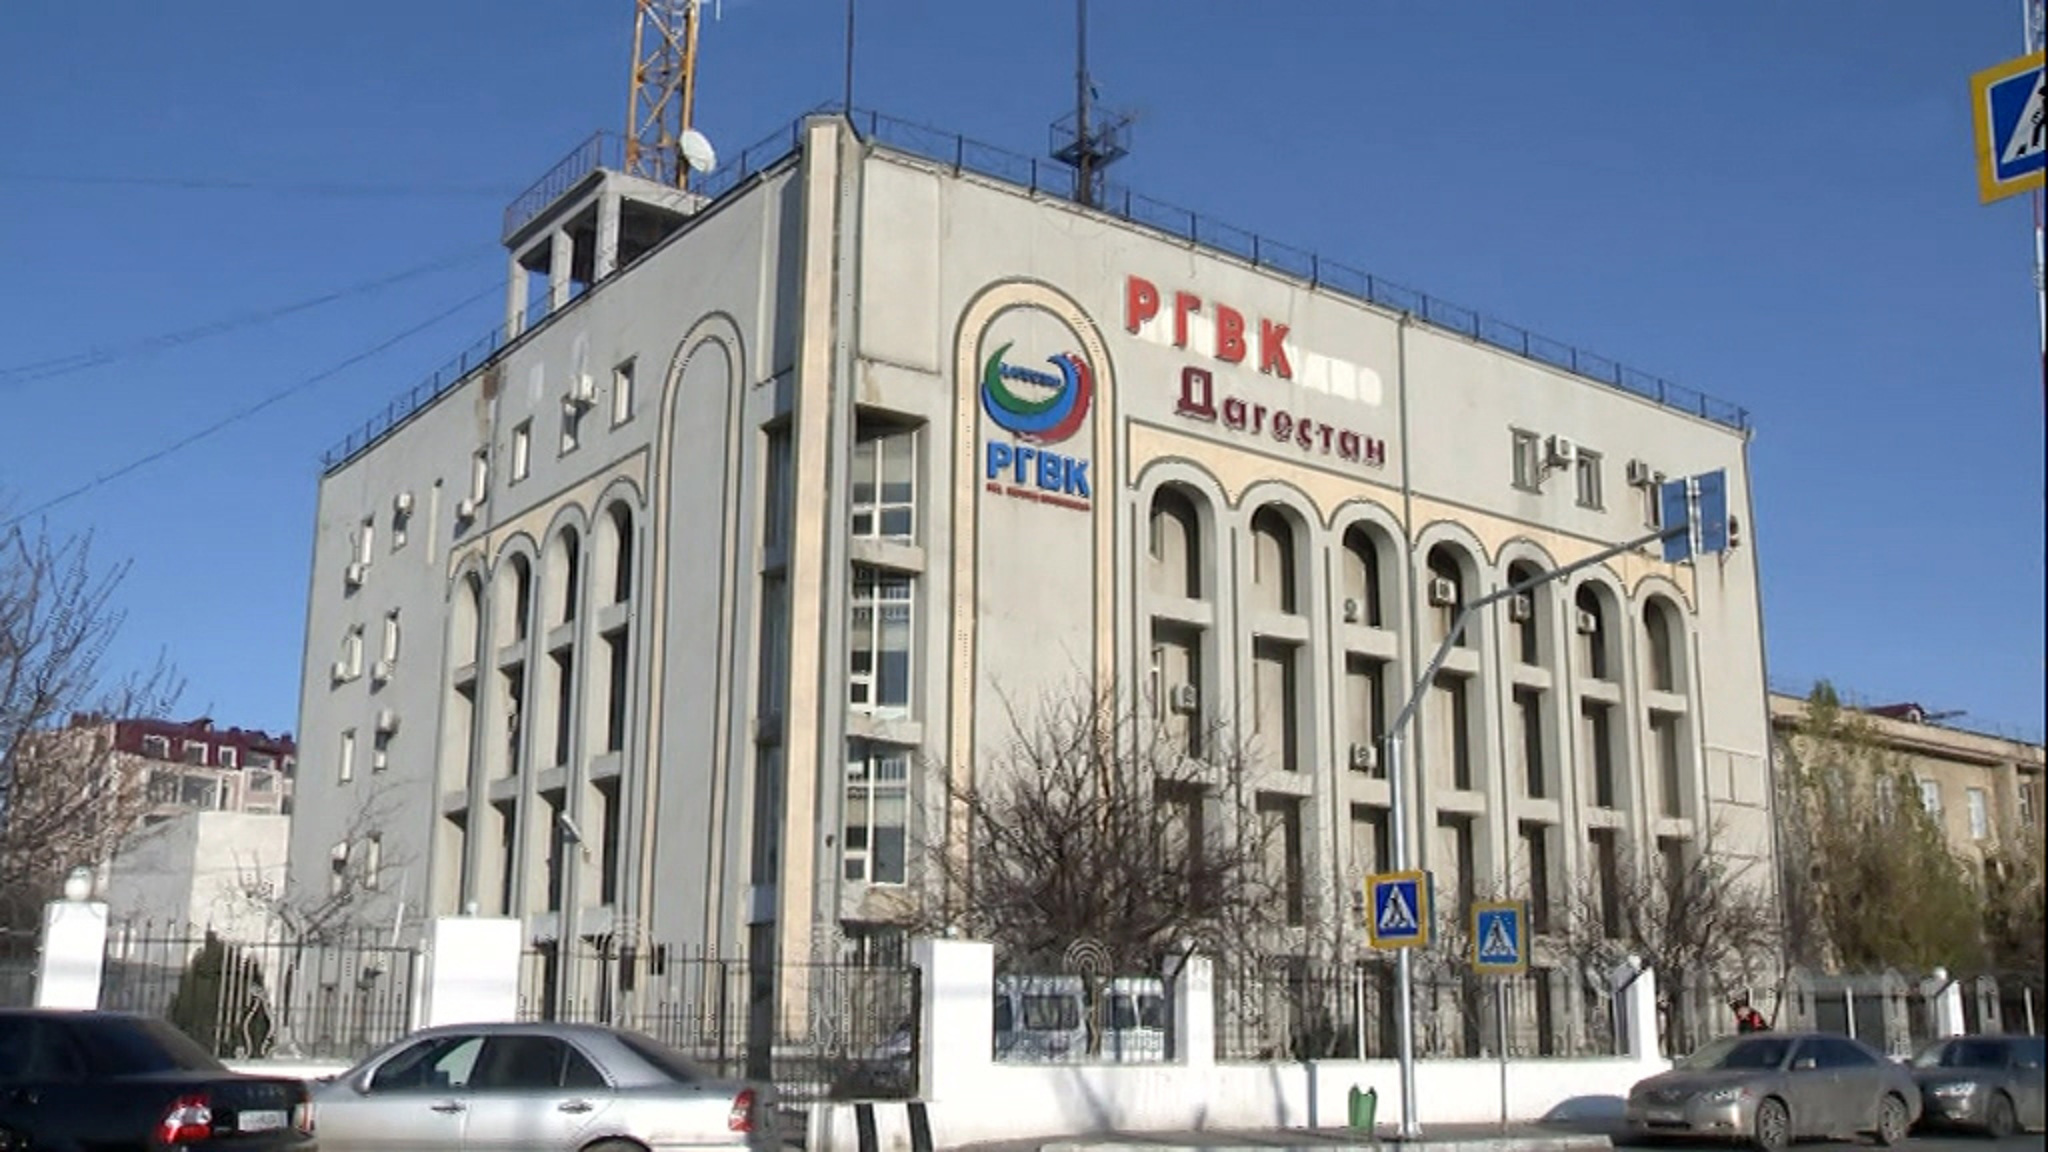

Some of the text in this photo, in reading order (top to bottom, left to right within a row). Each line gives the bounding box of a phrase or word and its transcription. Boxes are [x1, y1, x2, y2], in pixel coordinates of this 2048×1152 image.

[1126, 274, 1292, 379] РГВК
[1175, 366, 1386, 467] Дагестан
[986, 441, 1091, 498] РГВК
